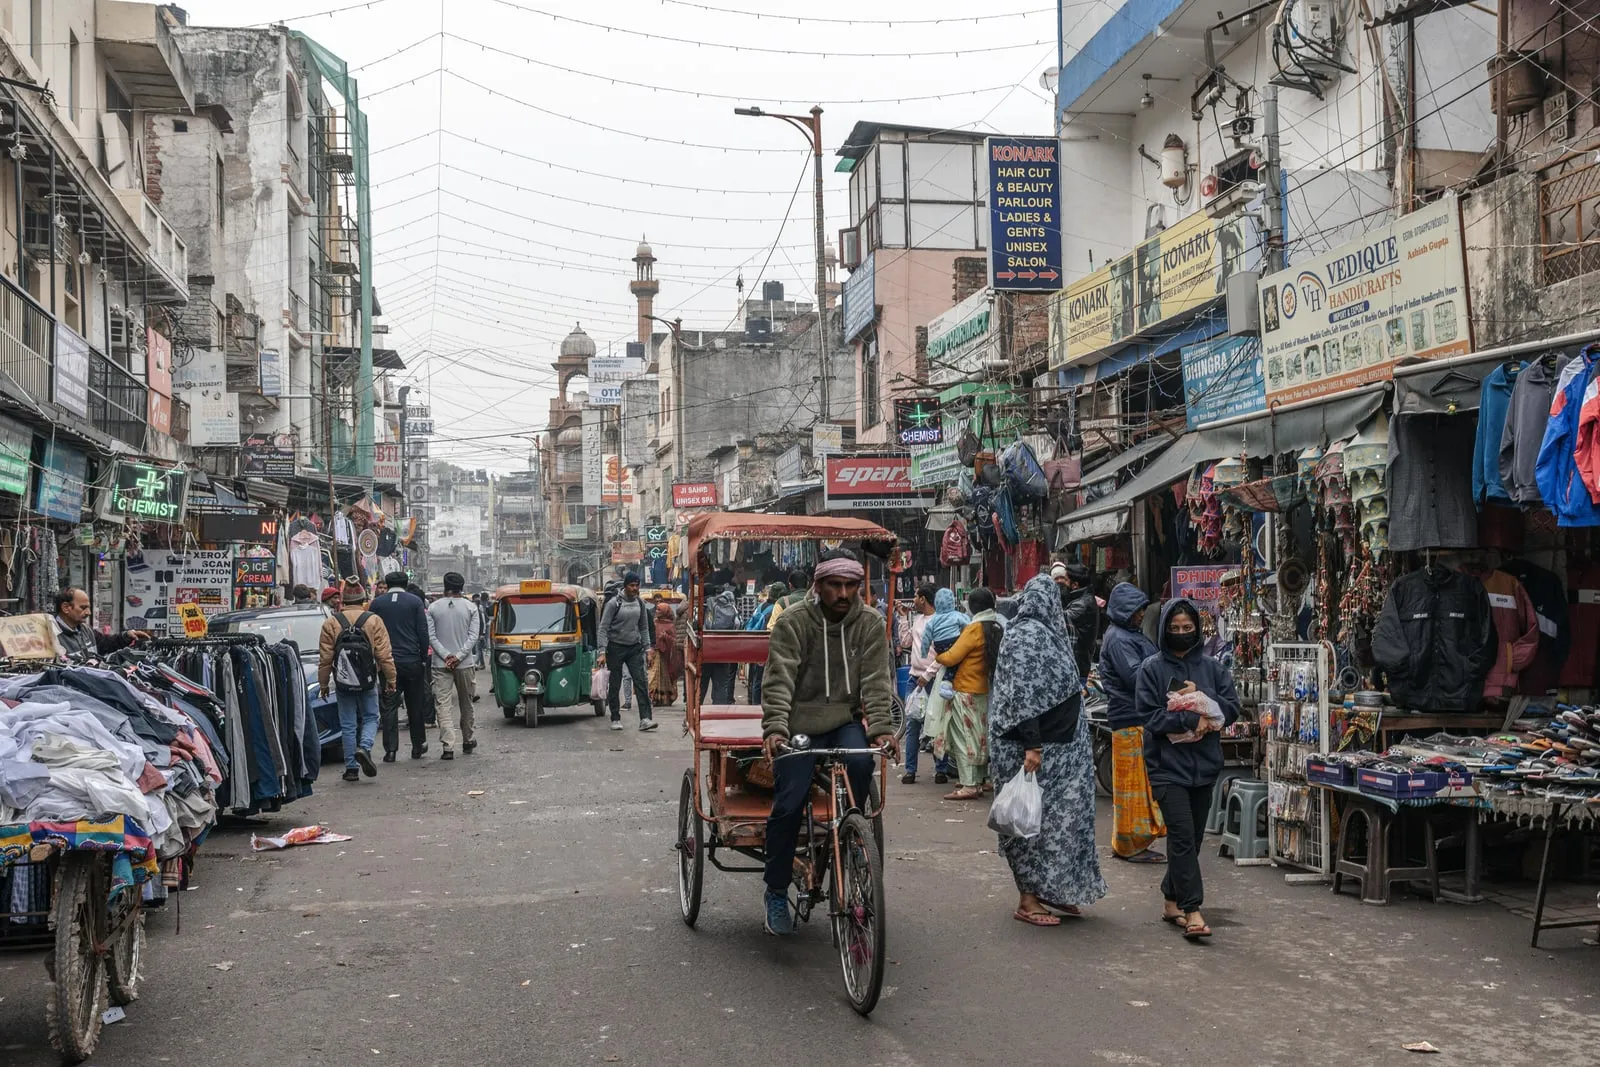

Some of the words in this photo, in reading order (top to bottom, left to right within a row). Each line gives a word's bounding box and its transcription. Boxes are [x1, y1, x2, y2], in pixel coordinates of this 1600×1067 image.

[992, 144, 1056, 162] KONARK
[998, 167, 1026, 178] HAIR
[1028, 167, 1052, 178] CUT
[996, 182, 1004, 192] &
[1007, 182, 1054, 193] BEAUTY
[998, 197, 1052, 208] PARLOUR
[999, 212, 1041, 223] LADIES
[1043, 212, 1052, 222] &
[1006, 227, 1046, 238] GENTS
[1005, 242, 1048, 252] UNISEX
[1163, 228, 1210, 273] KONARK
[1408, 245, 1428, 260] Ashish
[1428, 238, 1449, 251] Gupta
[1007, 256, 1047, 267] SALON
[1326, 236, 1398, 285] VEDIQUE
[1328, 268, 1402, 310] HANDICRAFTS
[1070, 284, 1108, 322] KONARK
[901, 430, 939, 441] CHEMIST
[676, 497, 700, 505] UNISEX
[702, 496, 714, 504] SPA
[202, 560, 231, 568] SCAN
[252, 562, 268, 572] ICE
[242, 574, 273, 584] CREAM
